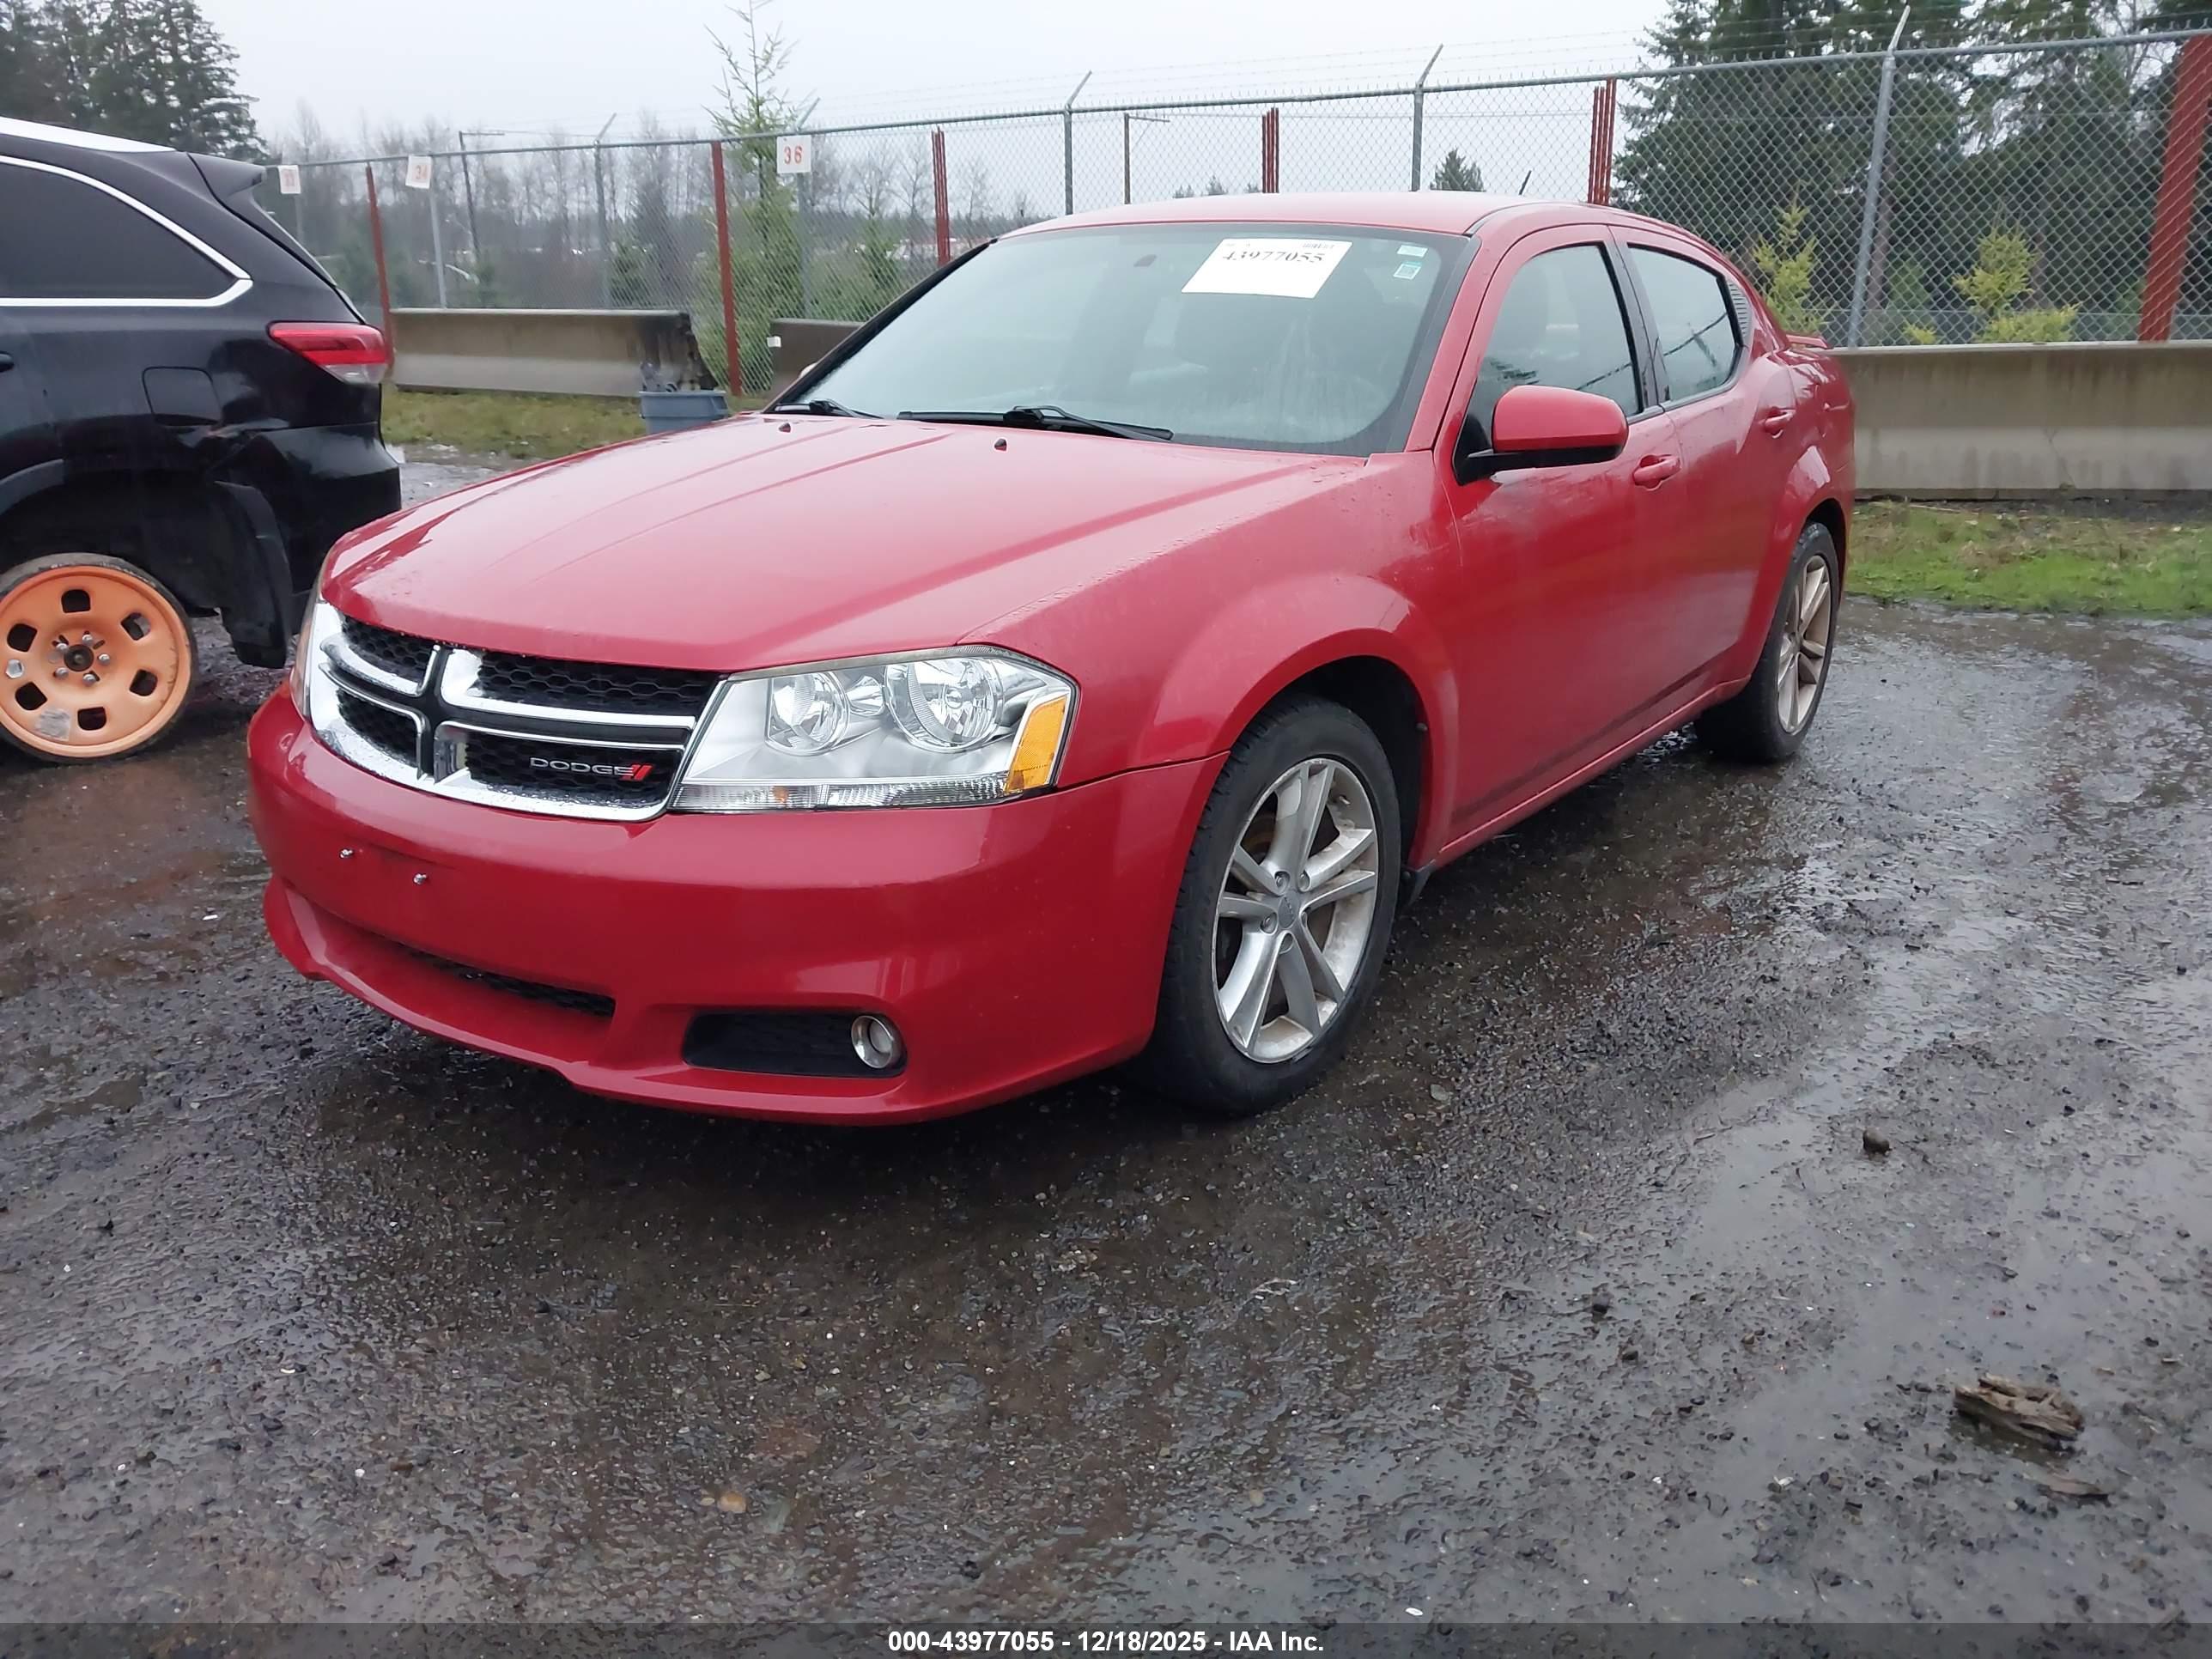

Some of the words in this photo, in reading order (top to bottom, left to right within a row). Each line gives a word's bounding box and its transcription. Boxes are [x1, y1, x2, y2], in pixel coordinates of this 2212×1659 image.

[784, 145, 803, 165] 36
[1223, 250, 1326, 263] 43977055
[529, 757, 635, 777] DODGE
